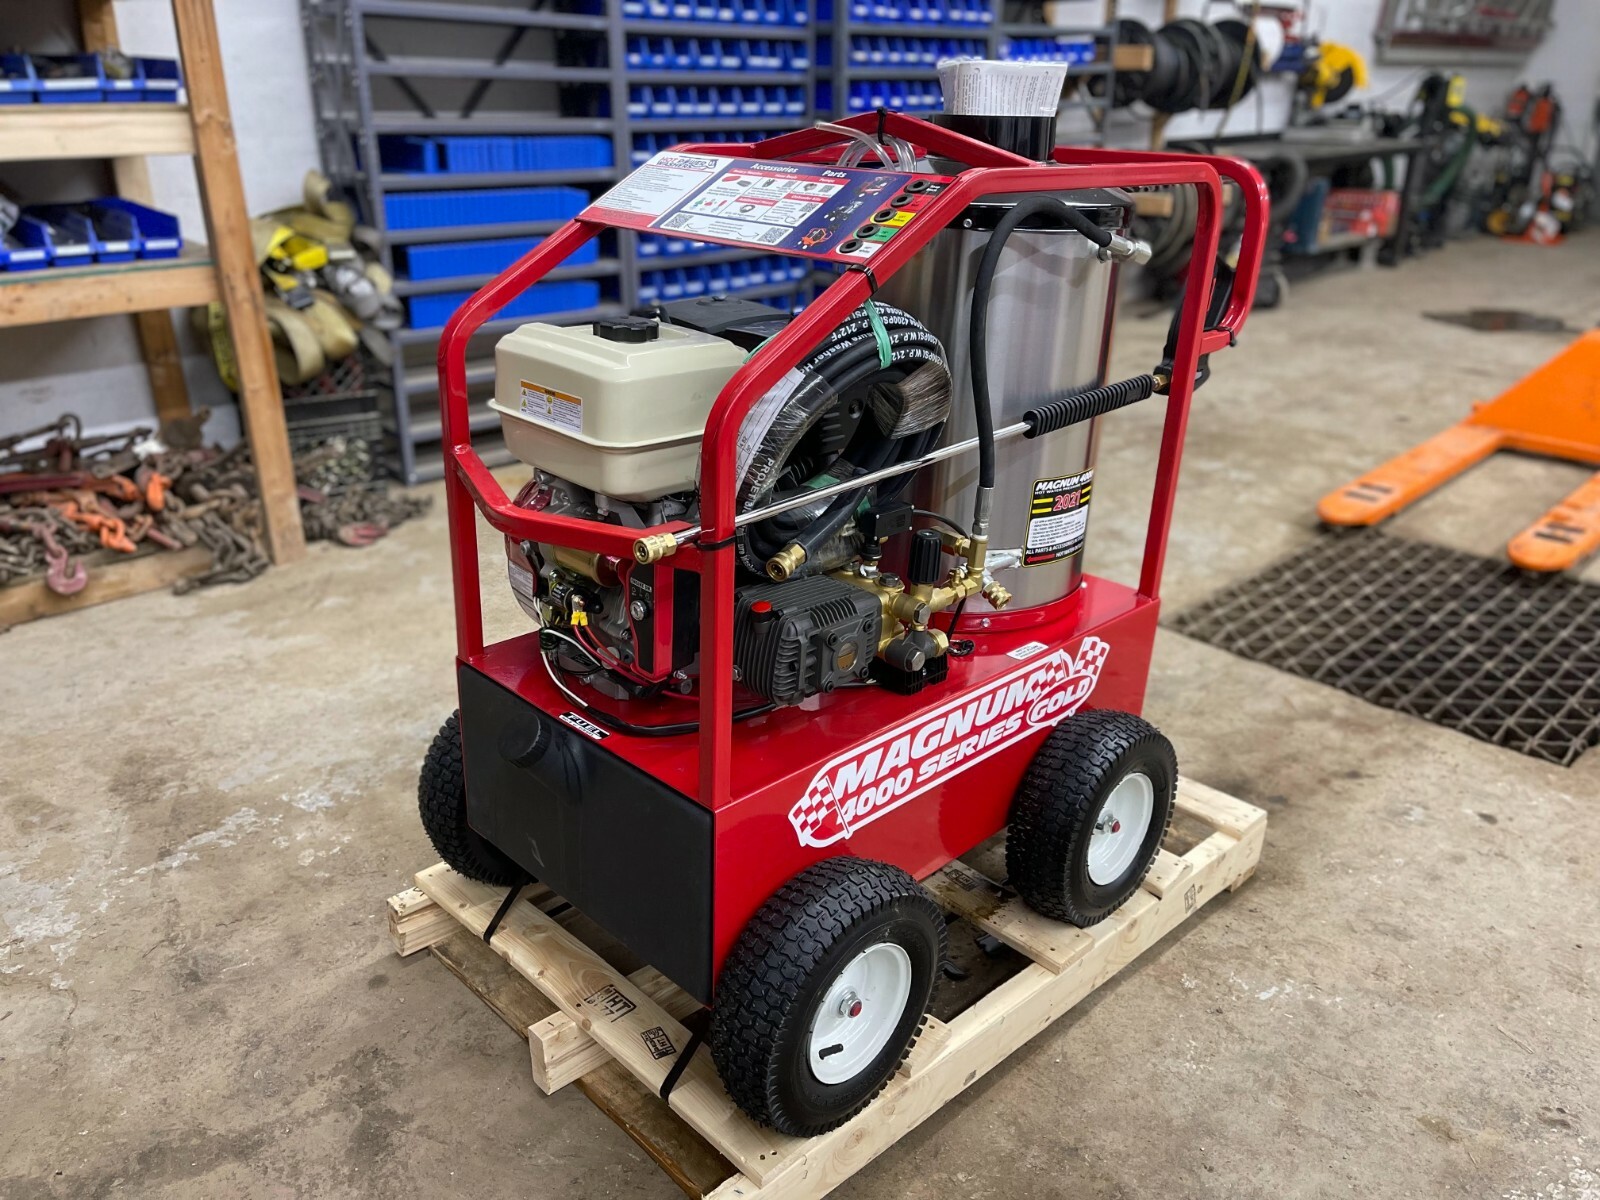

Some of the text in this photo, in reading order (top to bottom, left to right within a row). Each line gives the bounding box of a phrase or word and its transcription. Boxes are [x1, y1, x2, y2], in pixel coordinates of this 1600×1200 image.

[751, 163, 847, 178] Accessories Parts
[814, 340, 853, 364] Washer
[891, 350, 906, 361] 212
[800, 363, 814, 374] Ho
[1035, 476, 1081, 491] MAGNUM
[1053, 489, 1081, 512] 2021
[568, 714, 602, 736] FUEL
[831, 670, 1046, 801] MAGNUM
[837, 676, 1092, 825] 4000 SERIES GOLD
[606, 995, 632, 1013] HT
